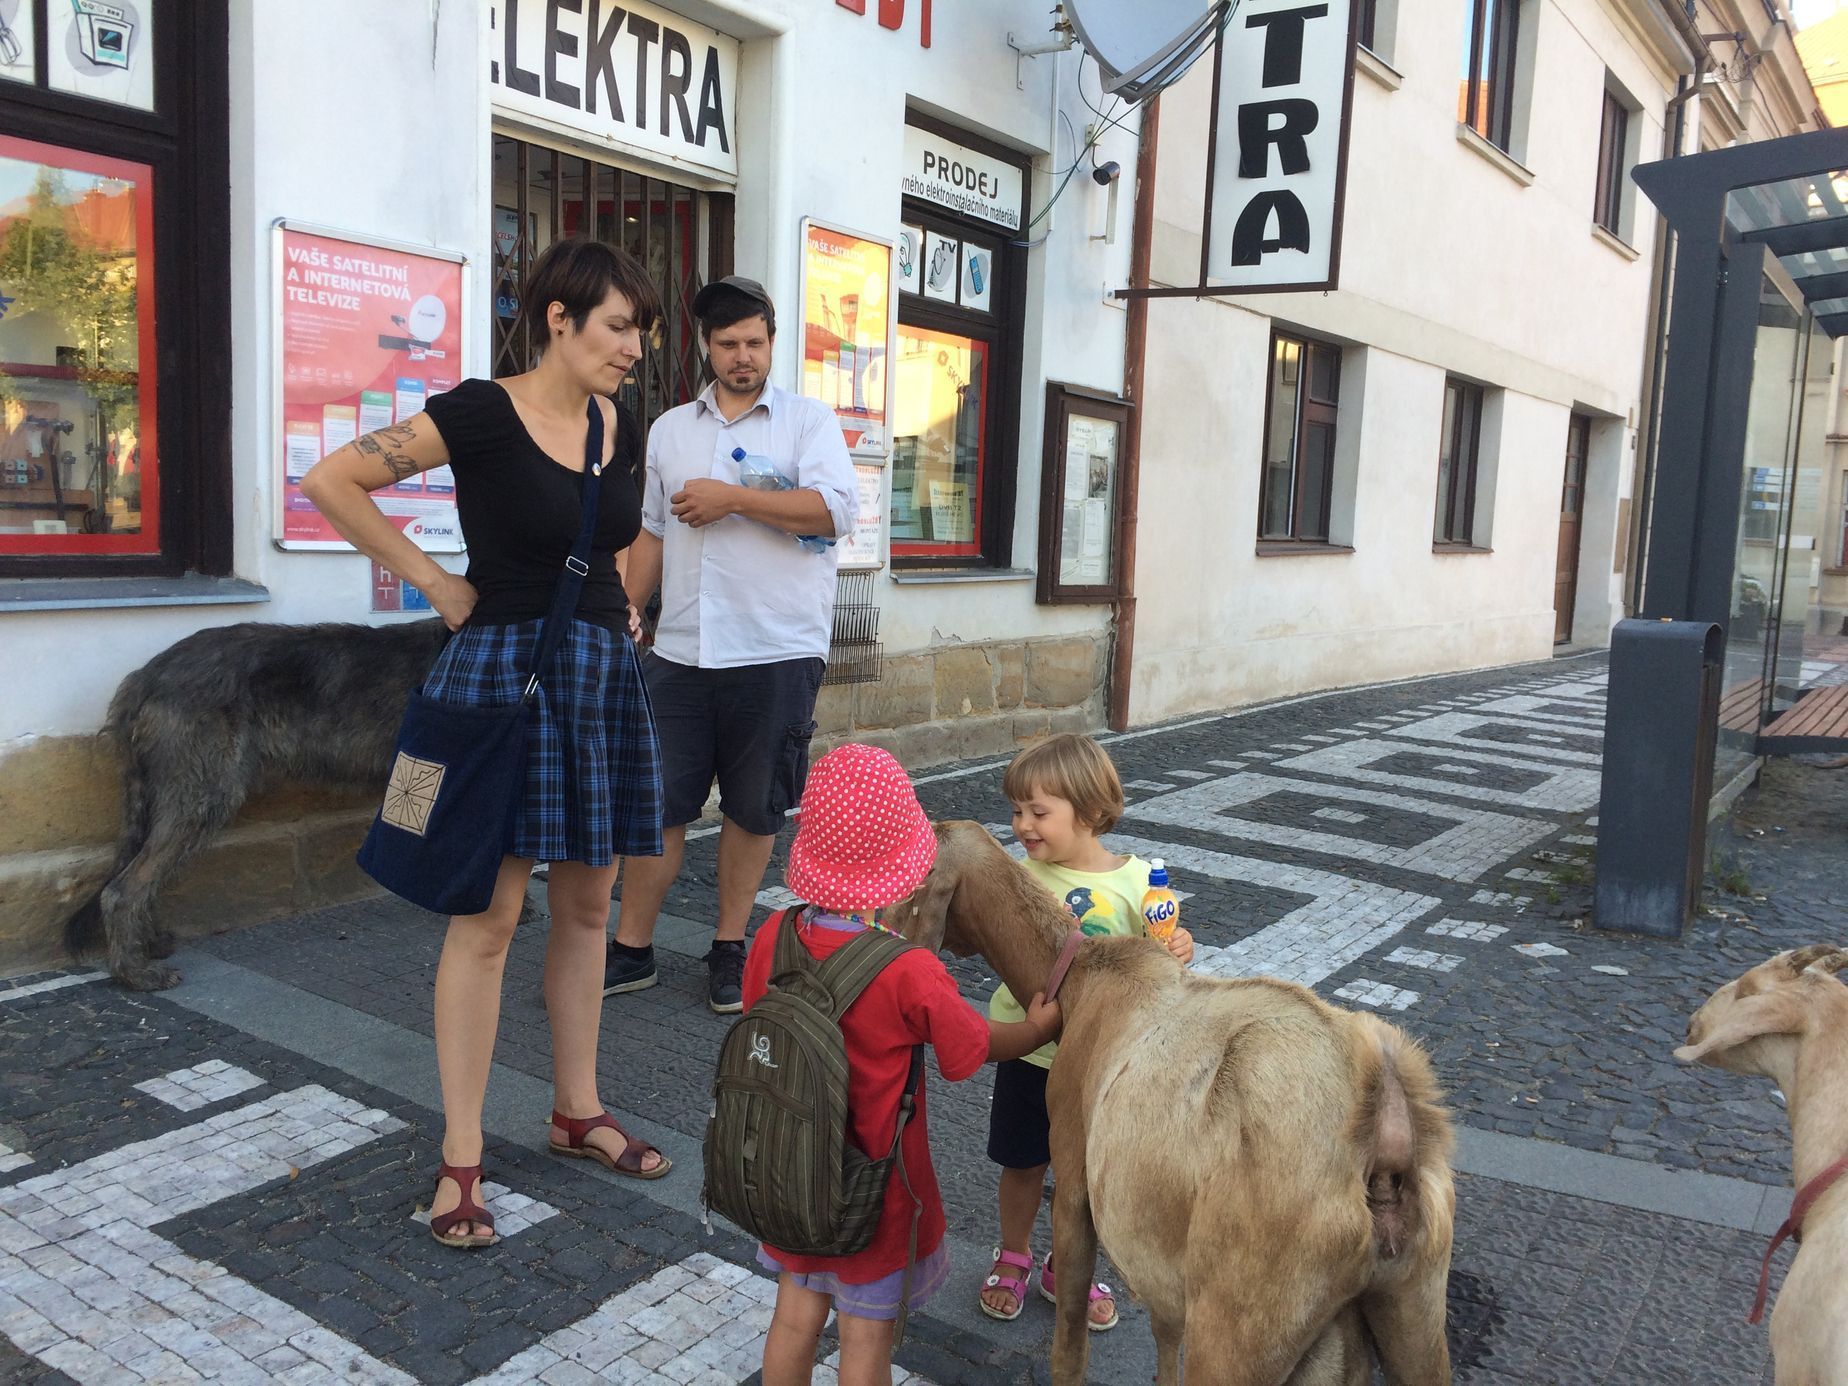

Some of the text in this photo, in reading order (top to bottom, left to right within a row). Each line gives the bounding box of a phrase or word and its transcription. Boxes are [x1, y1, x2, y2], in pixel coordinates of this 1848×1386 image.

[491, 0, 730, 154] LEKTRA
[923, 150, 998, 199] PRODEJ
[809, 238, 829, 253] VAŠE
[939, 240, 956, 253] TV
[287, 247, 409, 282] VAŠE SATELITNÍ
[286, 286, 361, 311] TELEVIZE
[287, 267, 411, 301] A INTERNETOVÁ
[423, 527, 454, 535] SKYLINK
